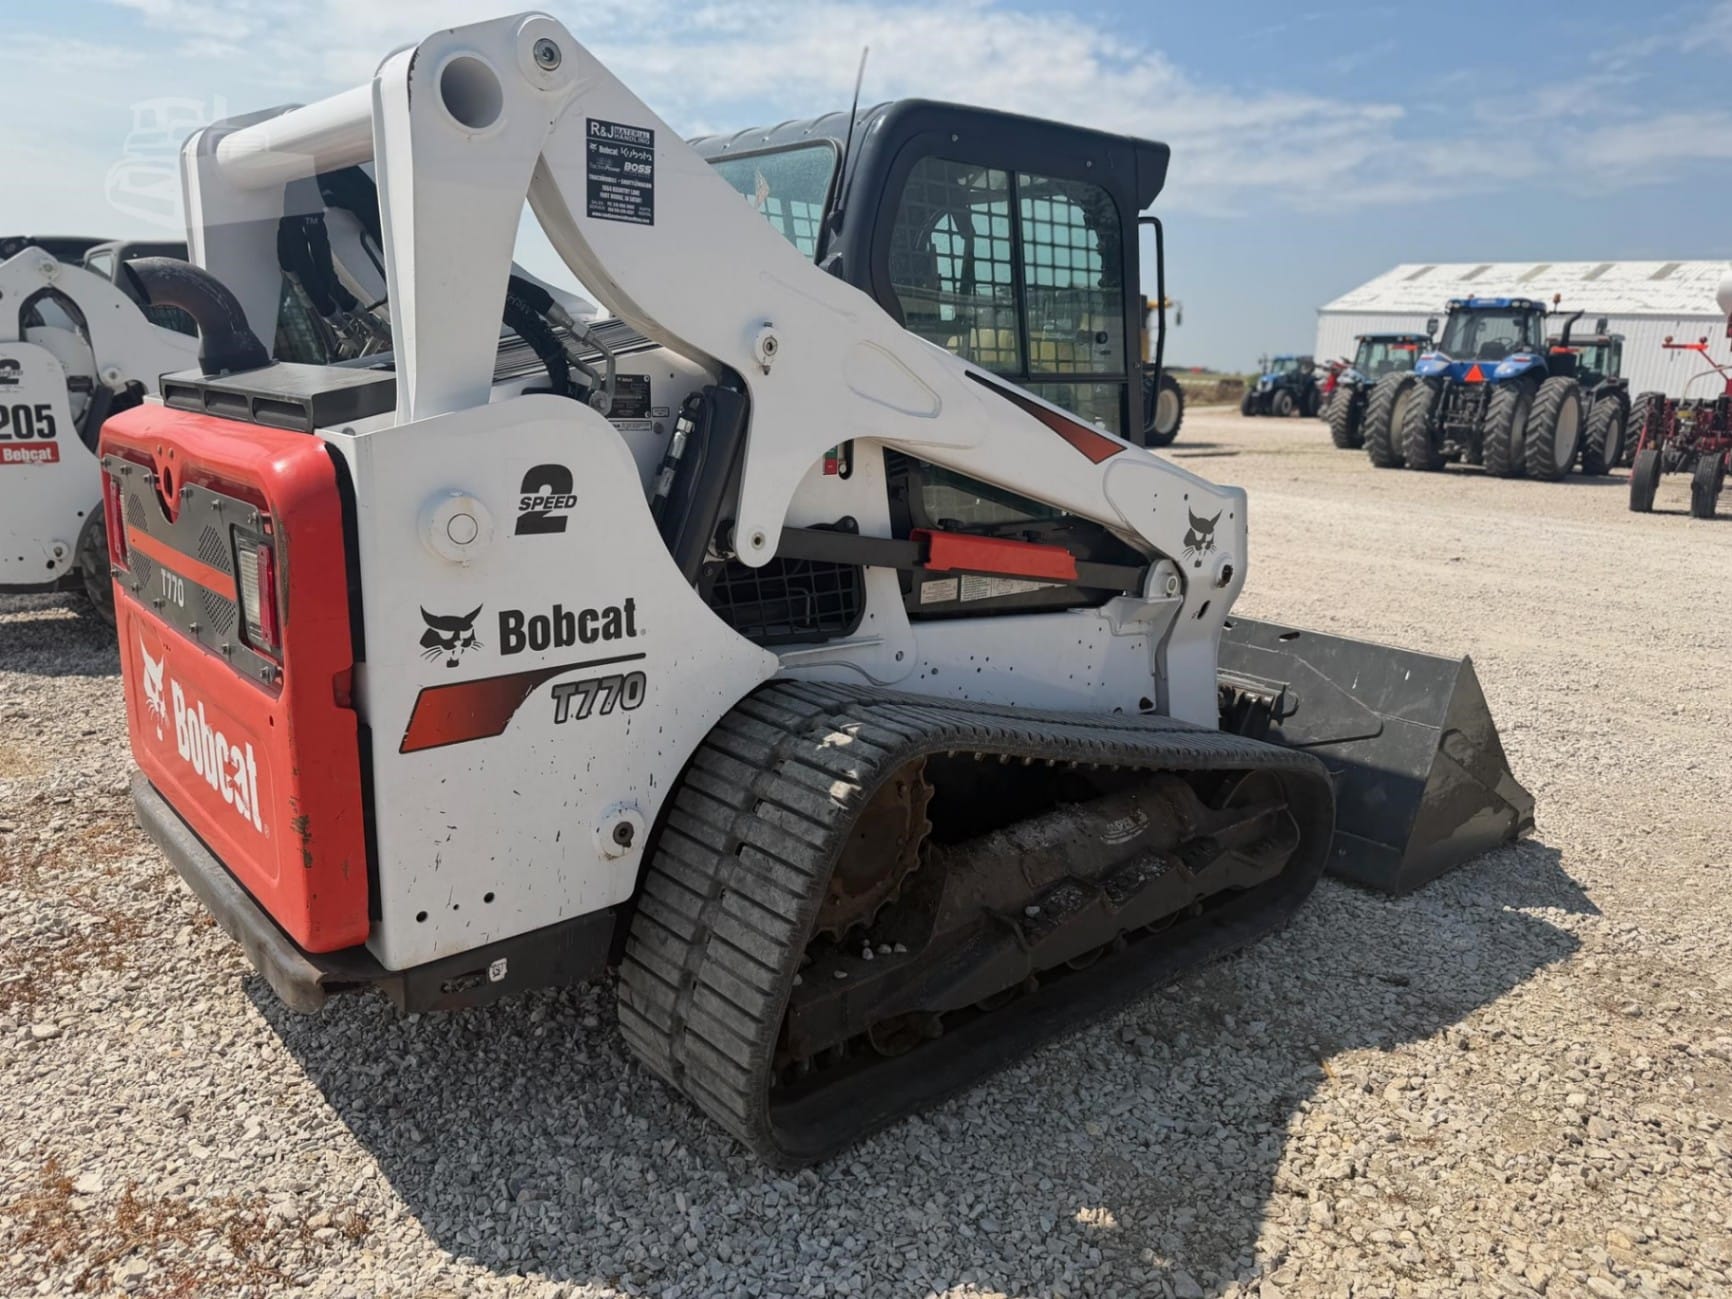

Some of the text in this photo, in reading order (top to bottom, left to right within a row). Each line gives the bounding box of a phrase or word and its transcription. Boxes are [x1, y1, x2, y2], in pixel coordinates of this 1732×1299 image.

[590, 121, 614, 138] R&J
[623, 161, 652, 174] BOSS
[0, 358, 21, 385] 2
[2, 447, 52, 462] Bobcat
[514, 463, 574, 536] 2
[518, 494, 577, 512] SPEED
[160, 567, 185, 607] T770
[498, 597, 638, 656] Bobcat
[551, 671, 647, 724] T770
[171, 678, 263, 834] Bobcat
